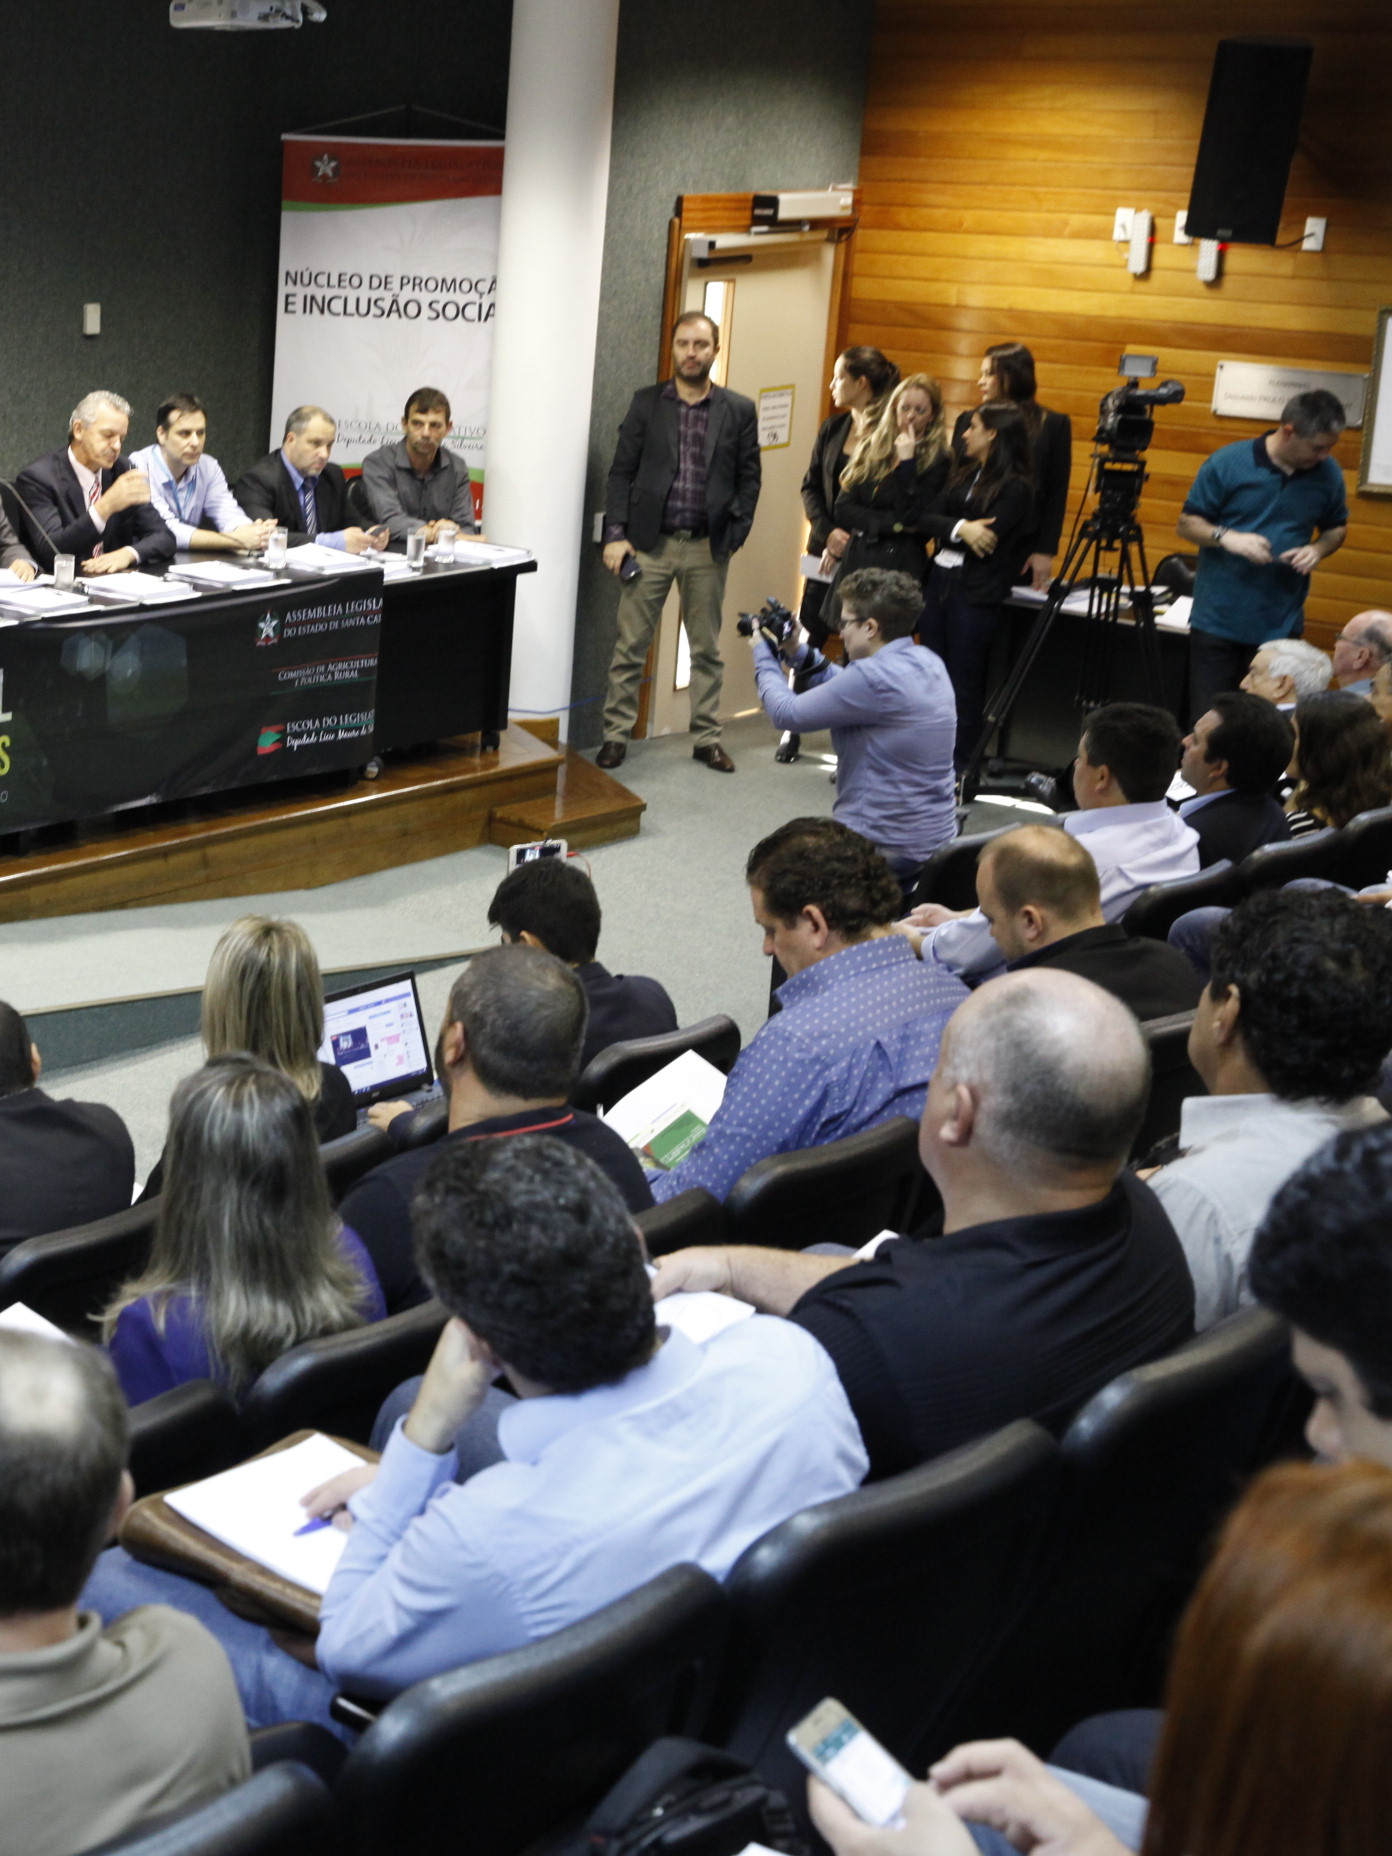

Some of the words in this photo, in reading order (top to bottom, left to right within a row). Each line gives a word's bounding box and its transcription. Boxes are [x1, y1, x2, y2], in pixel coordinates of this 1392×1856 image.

[284, 268, 363, 290] NÚCLEO
[368, 274, 394, 292] DE
[284, 293, 297, 315] E
[302, 293, 422, 321] INCLUSÃO
[337, 419, 382, 432] ESCOLA
[285, 602, 343, 624] ASSEMBLEIA
[283, 627, 296, 639] DO
[298, 621, 328, 636] ESTADO
[329, 620, 339, 631] DE
[341, 616, 365, 629] SANTA
[287, 718, 321, 733] ESCOLA
[322, 715, 337, 728] DO
